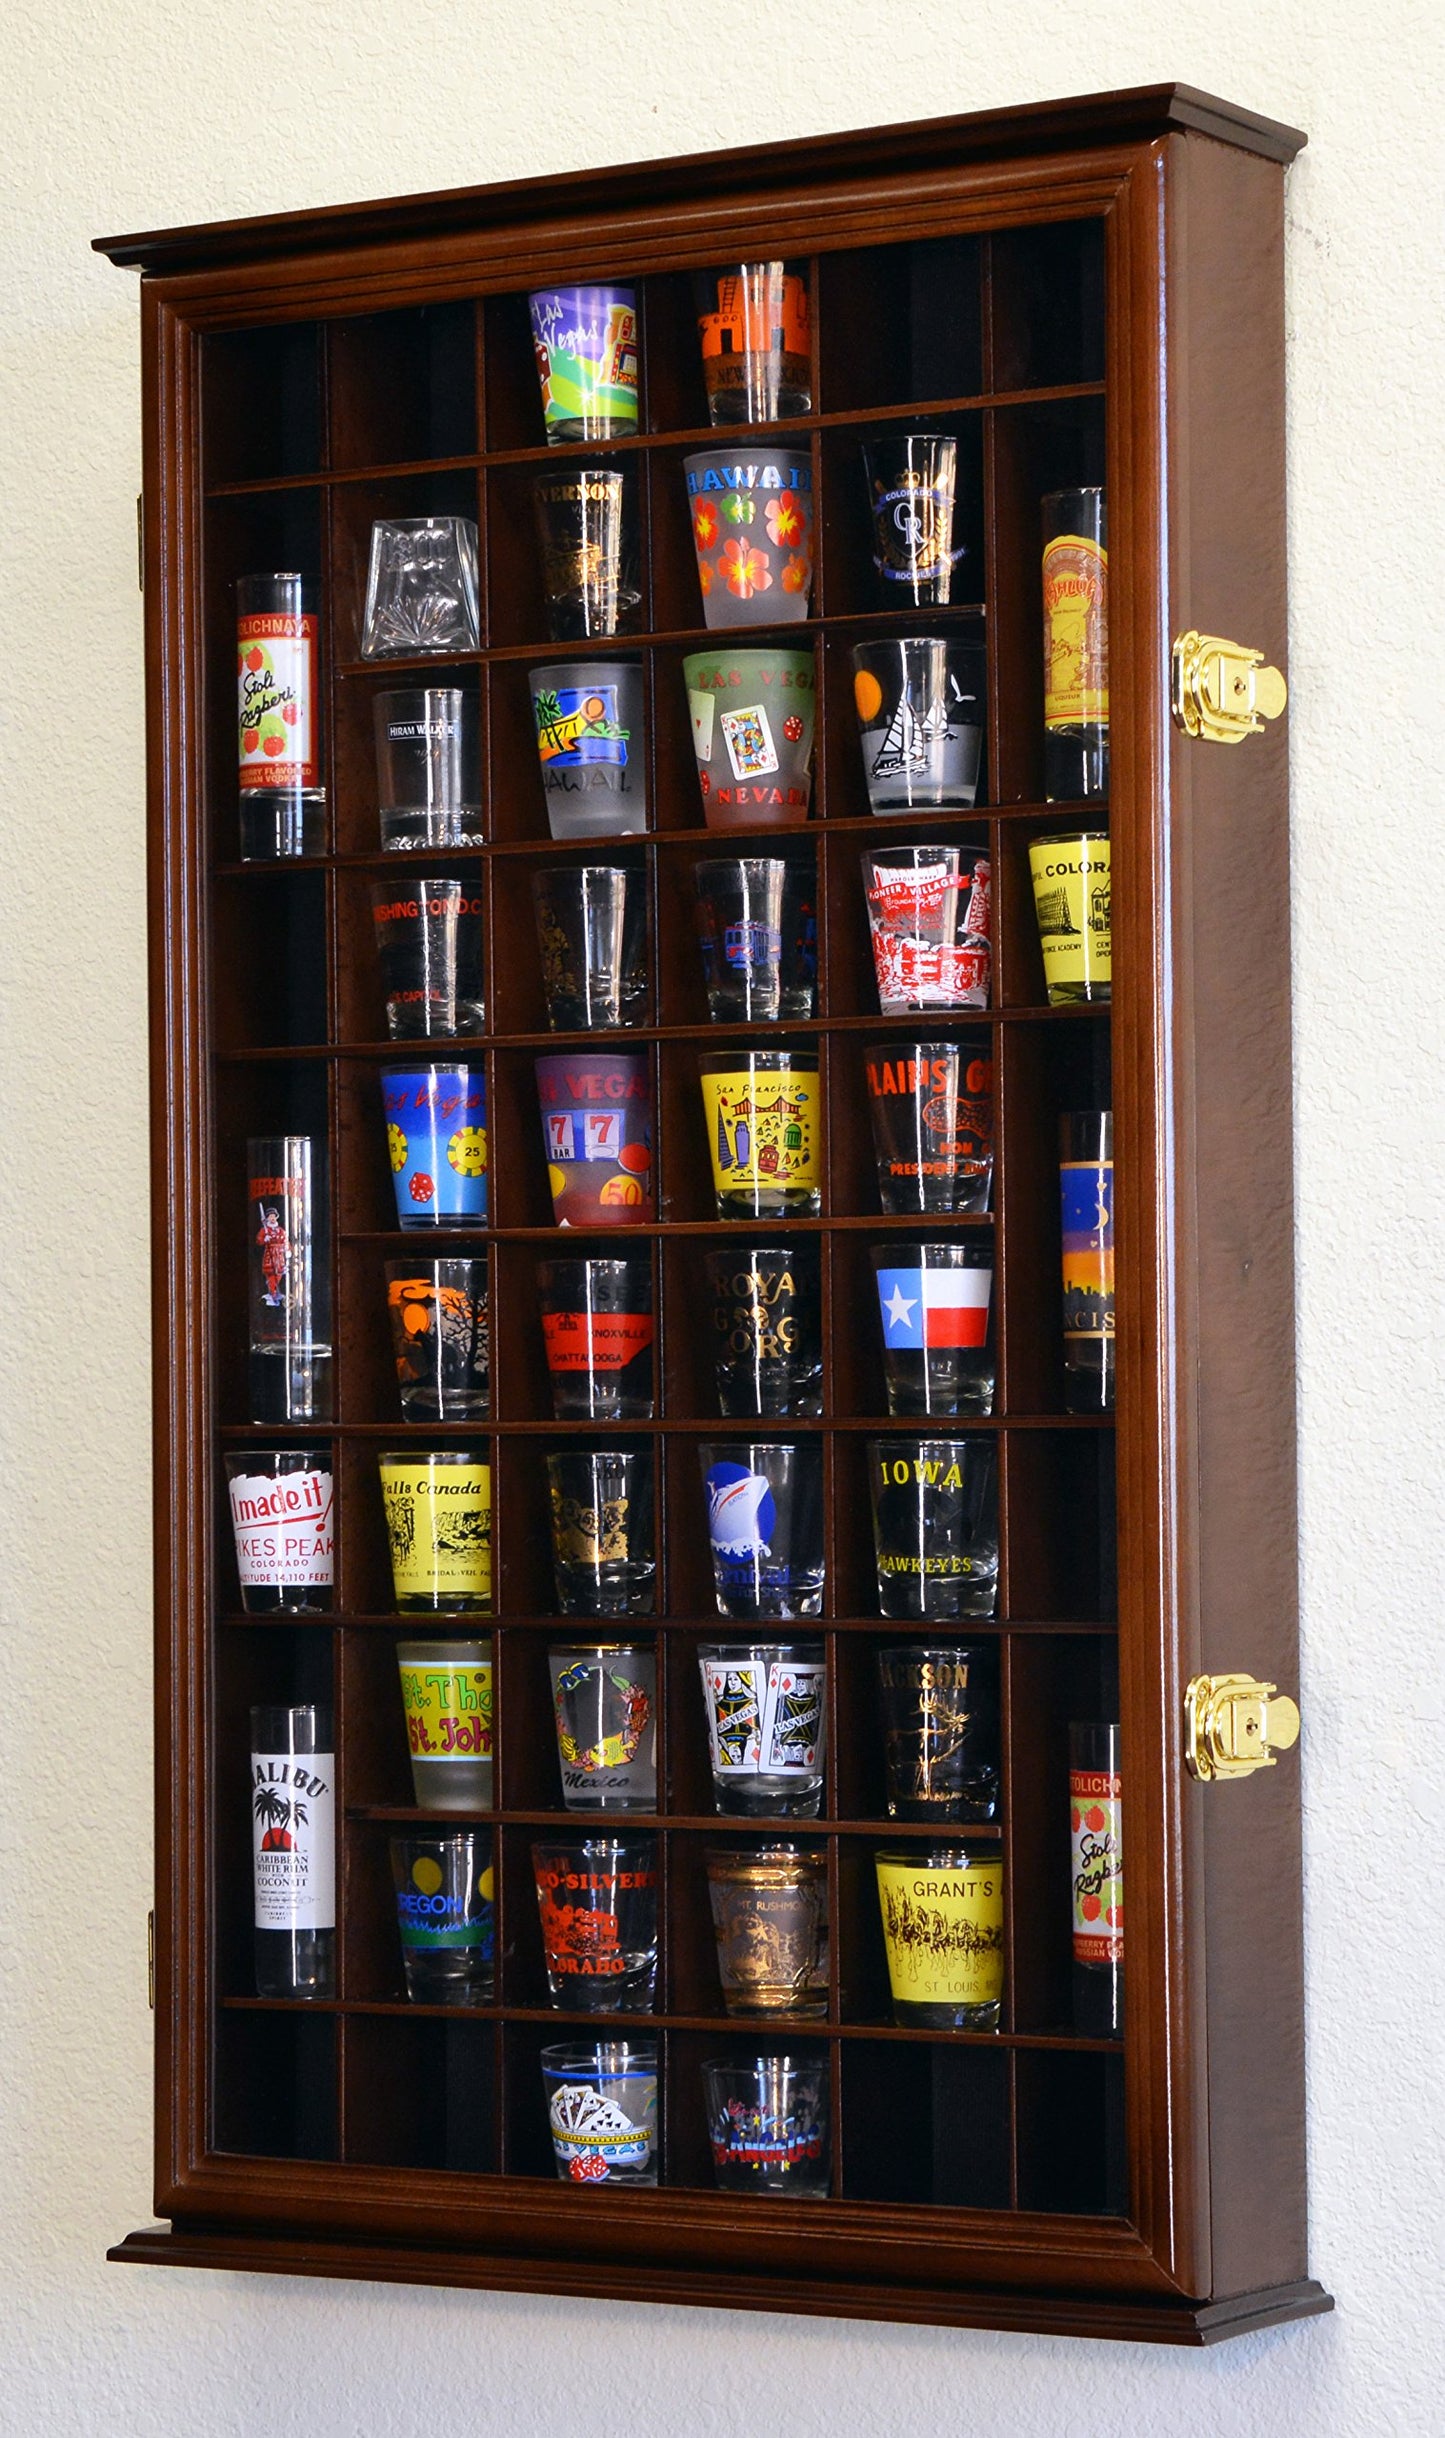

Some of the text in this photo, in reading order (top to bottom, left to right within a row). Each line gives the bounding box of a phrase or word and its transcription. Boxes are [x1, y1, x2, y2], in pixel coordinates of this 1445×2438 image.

[533, 295, 564, 331] Las
[543, 319, 601, 360] Vegas
[697, 670, 743, 690] LAS
[389, 725, 416, 737] HIRAM
[264, 766, 312, 778] FLAVOED
[1045, 861, 1111, 878] COLOR
[909, 875, 960, 896] VILLAGE
[1060, 943, 1082, 953] ACADEMY
[717, 1082, 802, 1097] San Francisco
[415, 1085, 484, 1119] Vega
[550, 1115, 614, 1144] 7 7
[464, 1145, 480, 1157] 25
[554, 1147, 570, 1160] BAR
[552, 1352, 625, 1365] CHATTAOOGA
[880, 1459, 964, 1489] IOWA
[416, 1481, 482, 1498] Canada
[239, 1483, 303, 1522] made
[284, 1537, 335, 1557] PEAK
[250, 1559, 309, 1570] COLORADO
[308, 1573, 330, 1583] FEET
[771, 1666, 780, 1676] K
[880, 1662, 969, 1691] ACKSON
[730, 1705, 760, 1728] VEGAS
[776, 1720, 793, 1736] LAS
[563, 1771, 631, 1790] Mexico
[256, 1855, 309, 1864] CARIBBEAN
[257, 1864, 282, 1874] WHITE
[913, 1880, 993, 1899] GRANT'S
